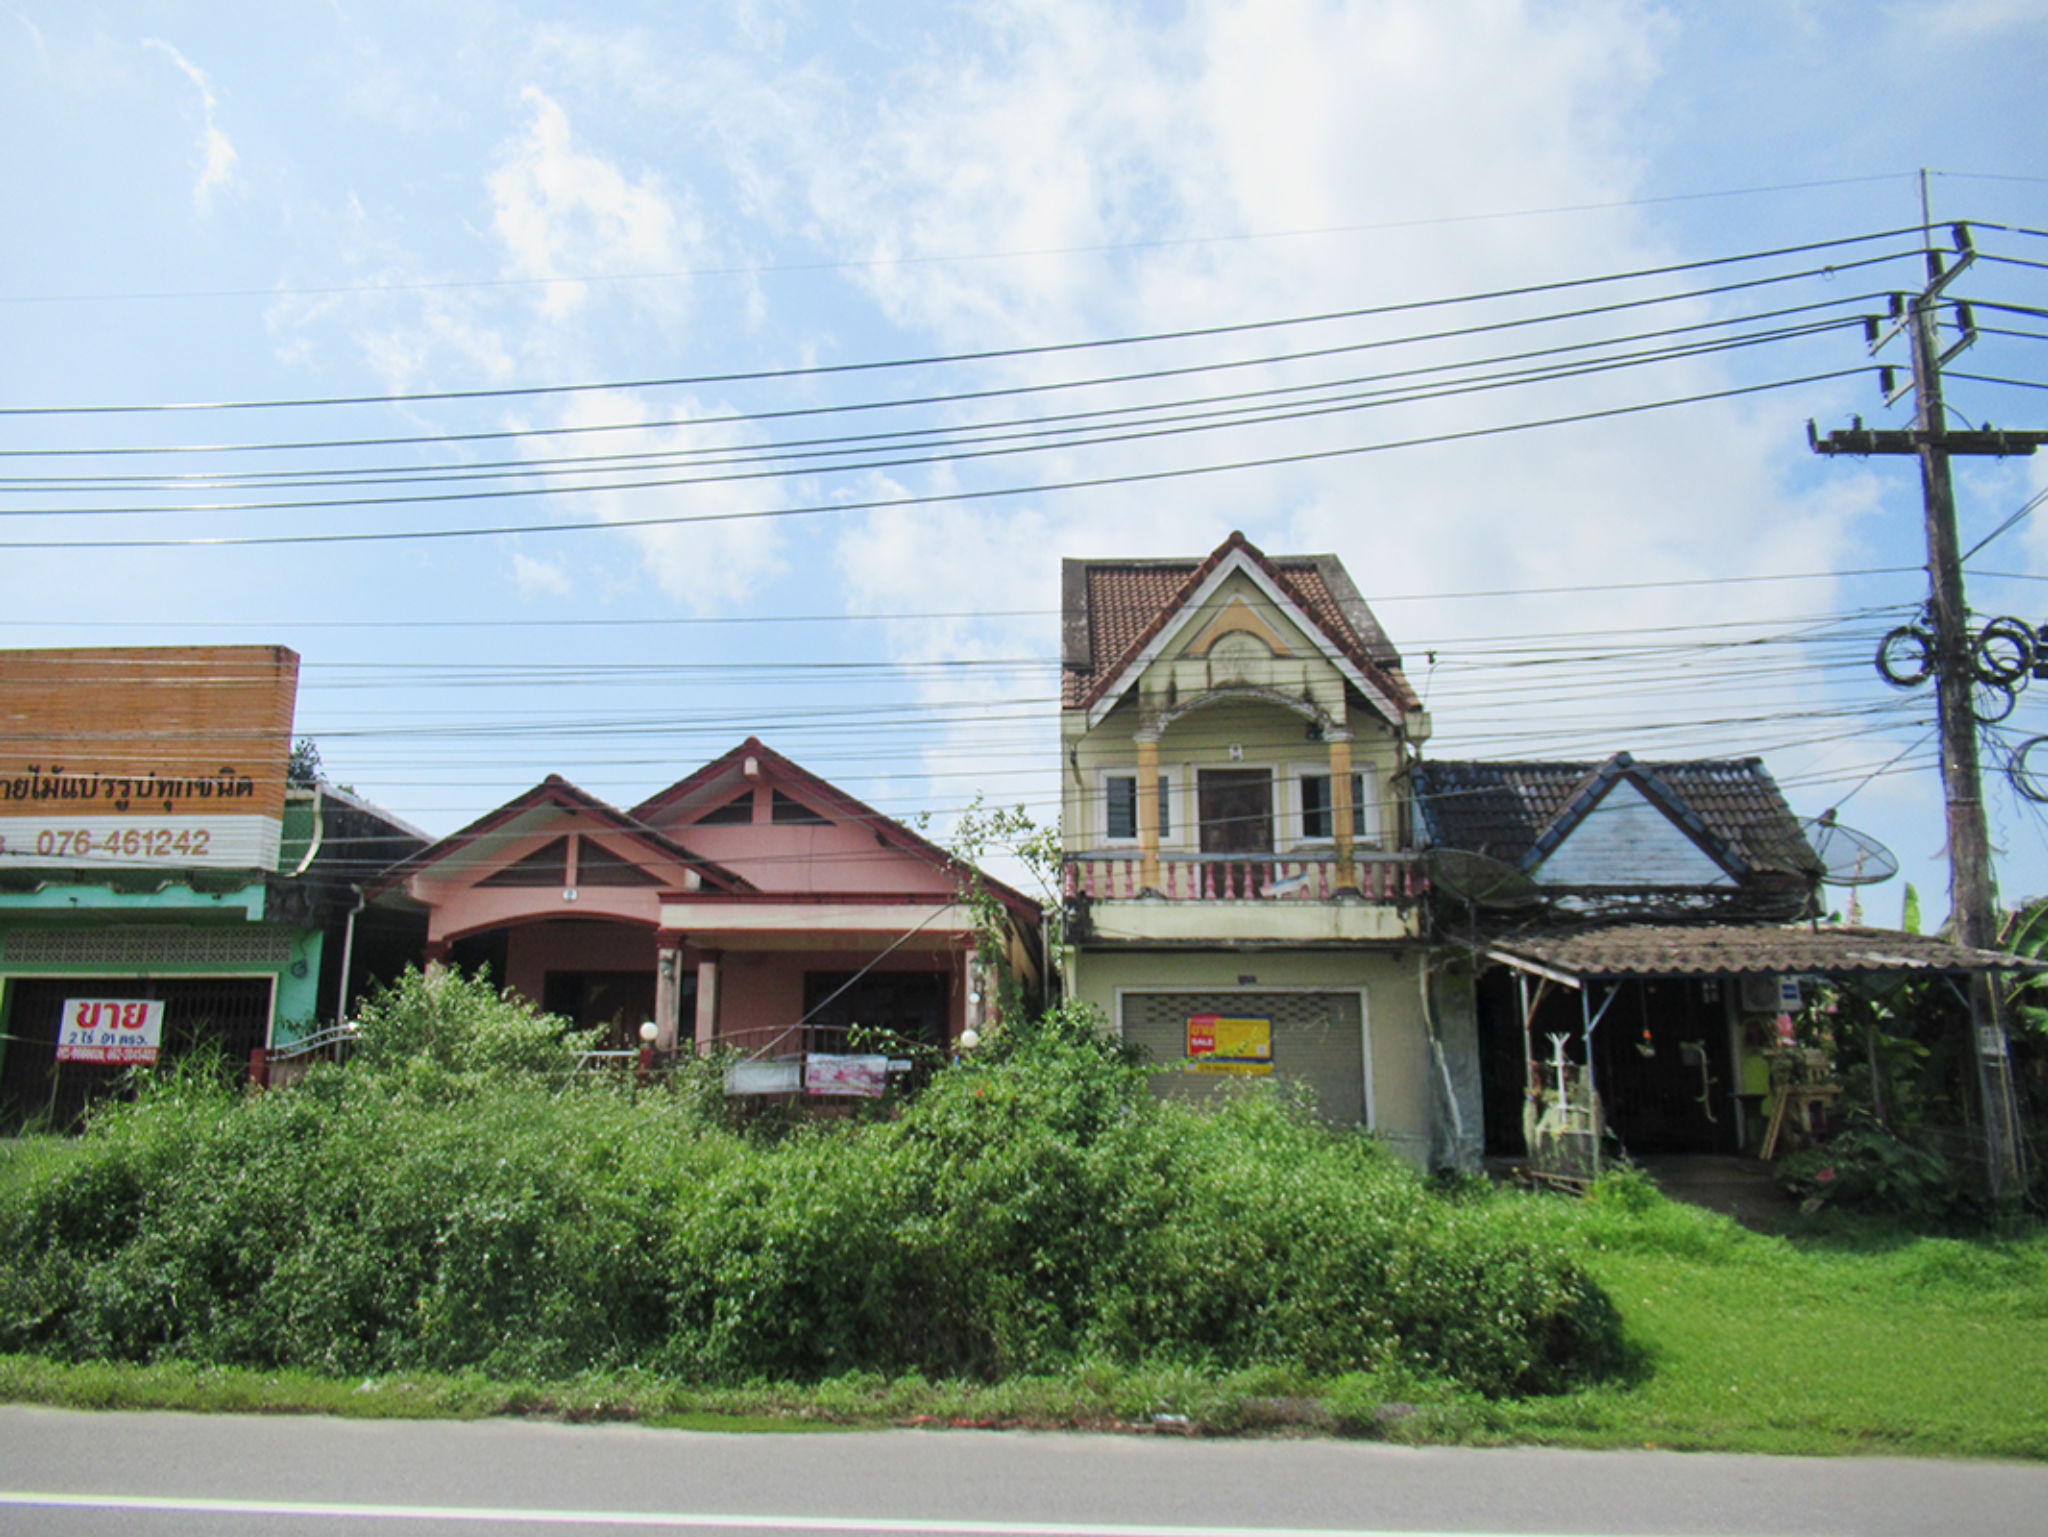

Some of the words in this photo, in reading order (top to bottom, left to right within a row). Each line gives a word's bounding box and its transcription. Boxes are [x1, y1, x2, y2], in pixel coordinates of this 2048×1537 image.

[37, 829, 211, 856] 076-461242
[76, 1002, 149, 1029] ขาย
[1191, 1037, 1214, 1046] SALE
